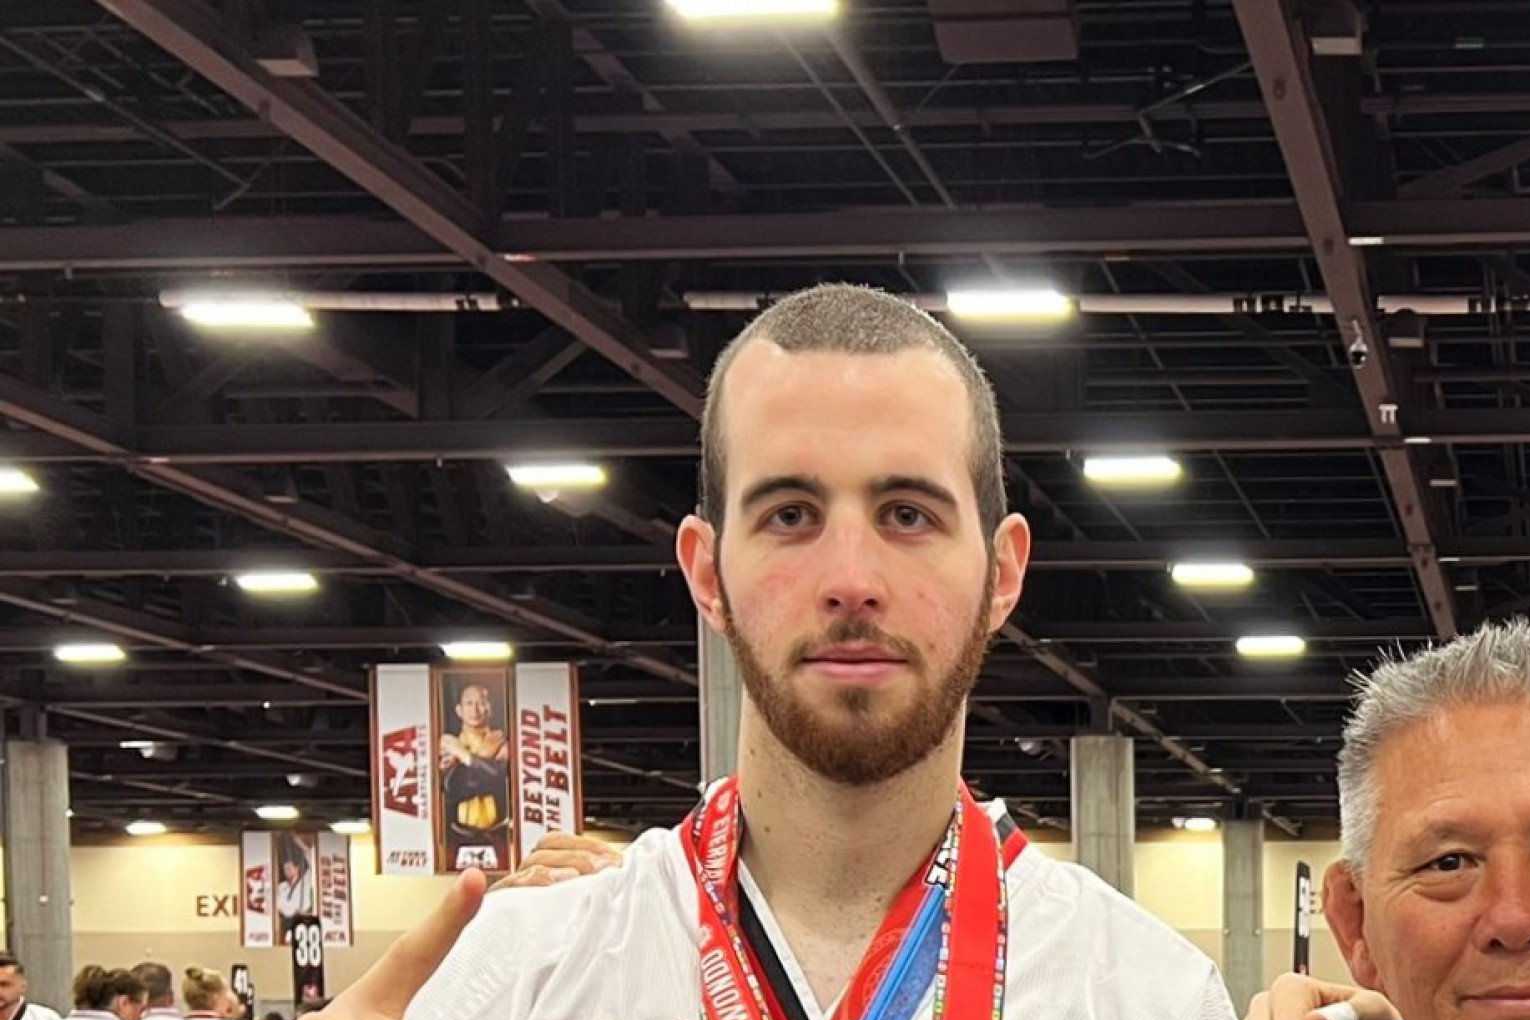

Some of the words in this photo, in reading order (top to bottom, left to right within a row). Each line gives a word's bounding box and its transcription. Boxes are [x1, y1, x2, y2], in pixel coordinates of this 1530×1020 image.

[521, 708, 543, 825] BEYOND
[543, 704, 570, 796] BELT
[333, 853, 347, 902] BELT
[196, 894, 240, 918] EXI
[294, 923, 322, 967] 38
